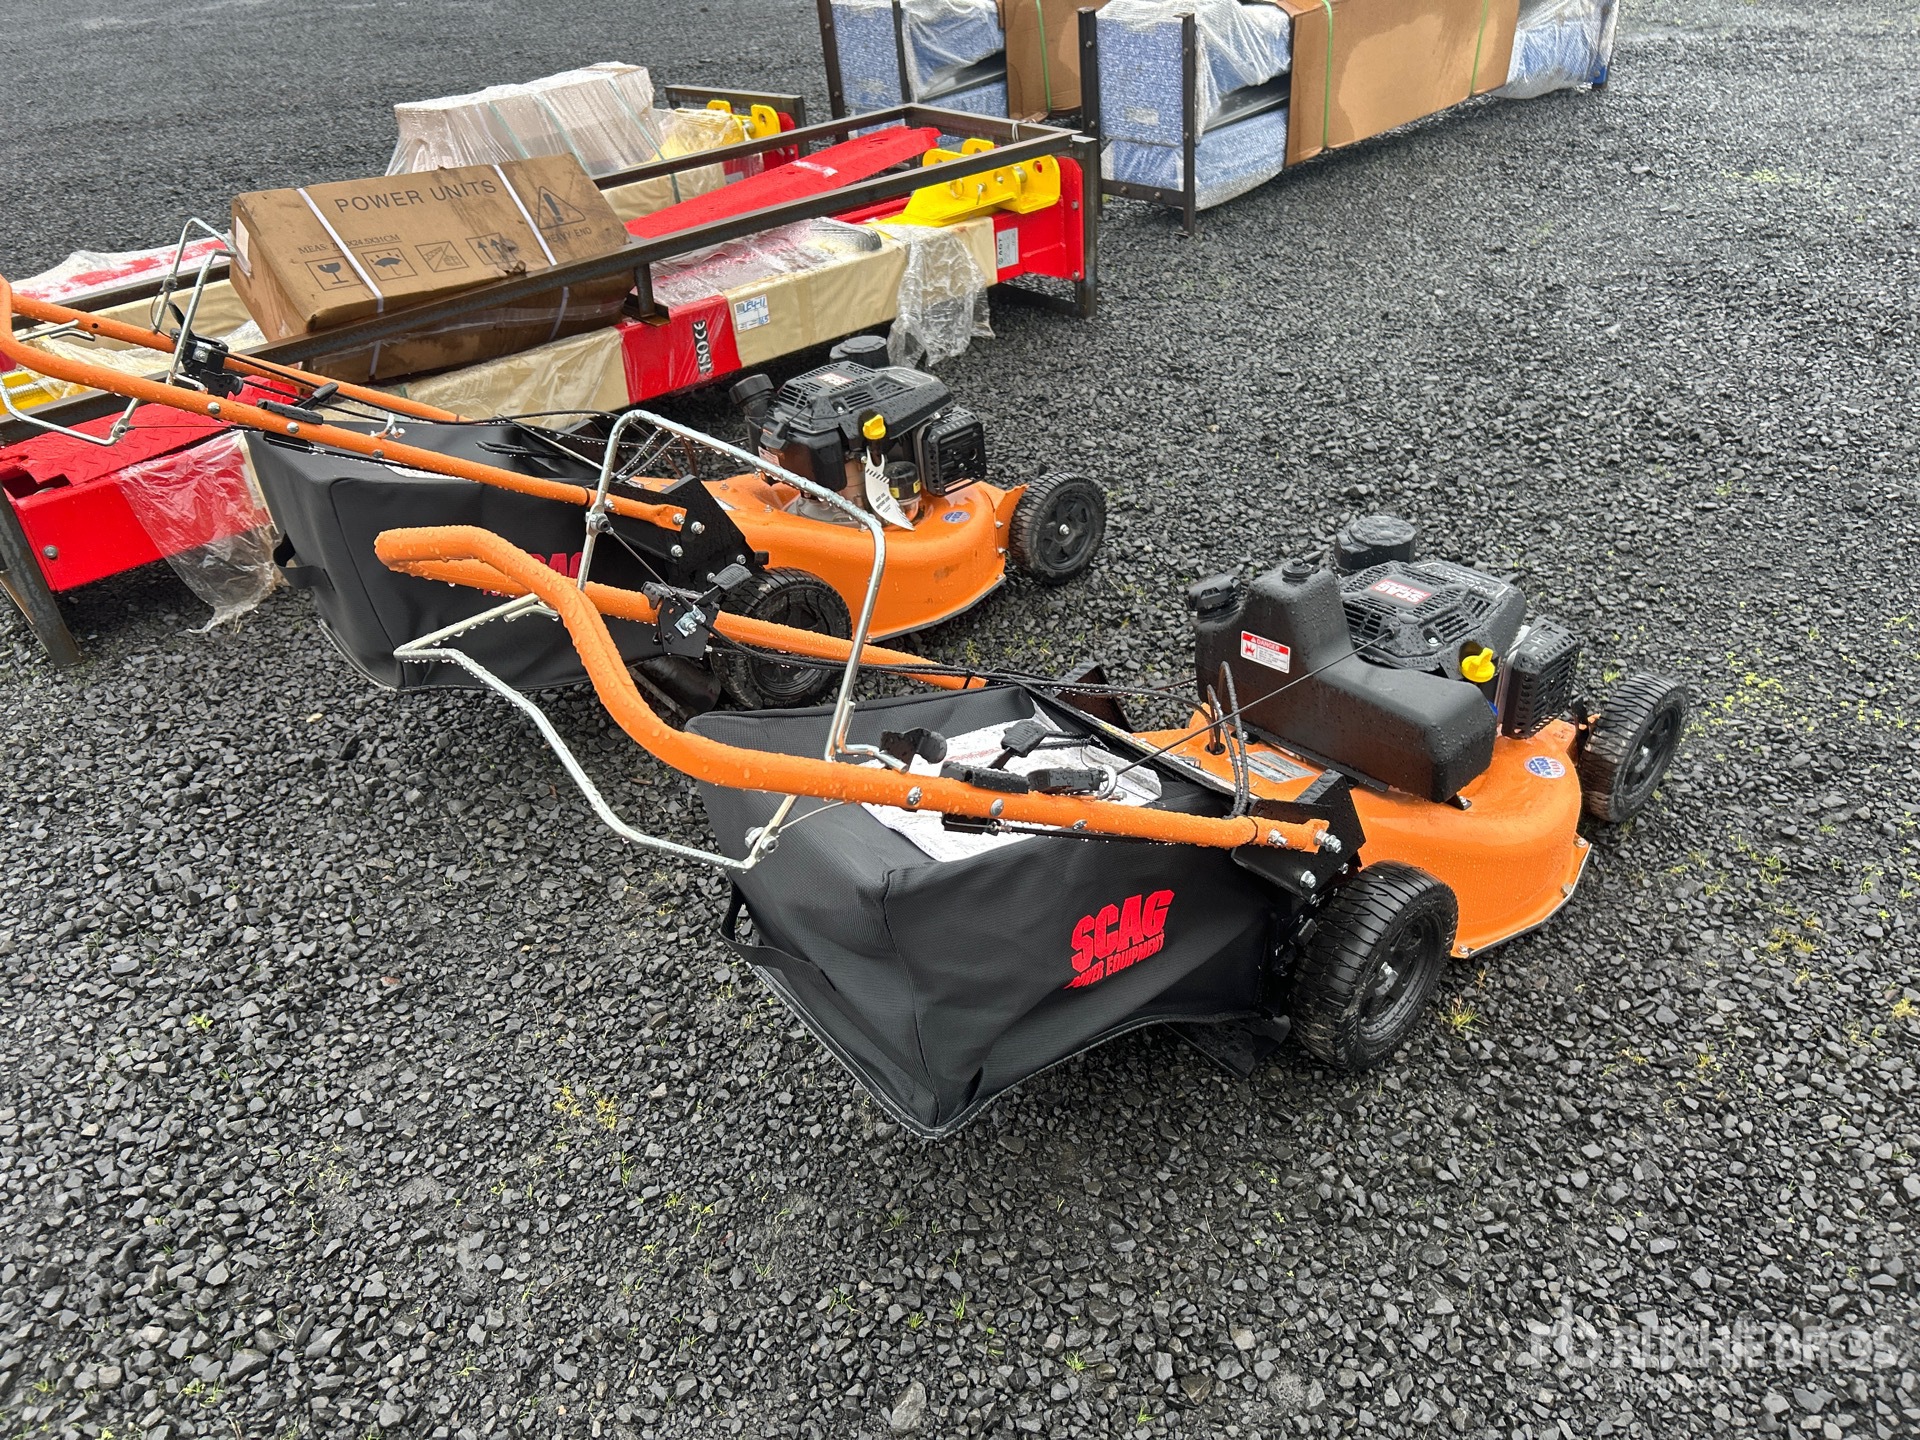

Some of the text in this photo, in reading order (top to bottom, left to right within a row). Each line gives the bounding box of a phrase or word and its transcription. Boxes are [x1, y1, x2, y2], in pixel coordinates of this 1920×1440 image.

[334, 180, 497, 213] POWER UNITS
[573, 226, 592, 238] END
[297, 243, 329, 255] MEAS:
[1256, 638, 1280, 652] DANGER
[1071, 889, 1175, 973] SCAG
[1106, 932, 1165, 977] EQUIPMENT
